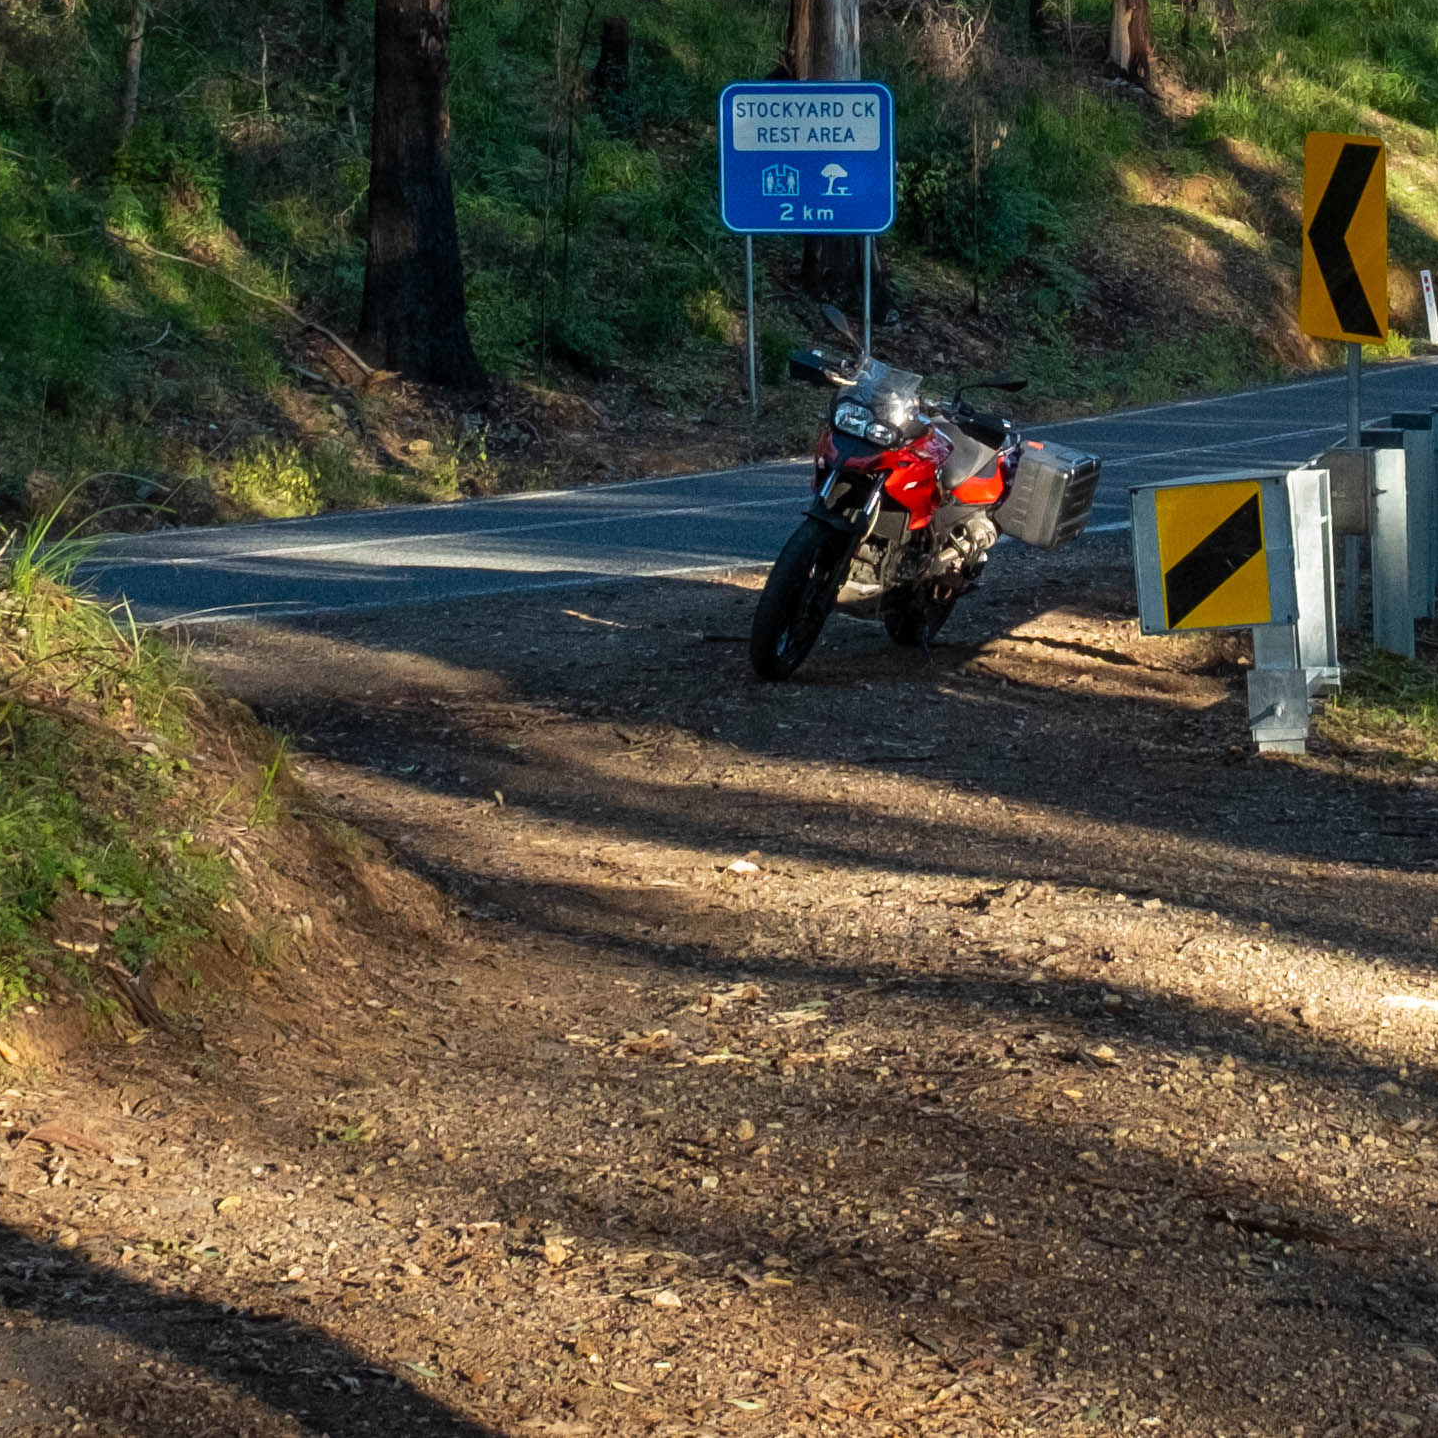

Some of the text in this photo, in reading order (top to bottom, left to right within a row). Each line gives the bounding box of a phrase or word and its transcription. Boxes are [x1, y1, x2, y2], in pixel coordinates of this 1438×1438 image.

[736, 101, 875, 118] STOCKYARD CK
[757, 127, 855, 143] REST AREA
[779, 203, 834, 221] 2 km
